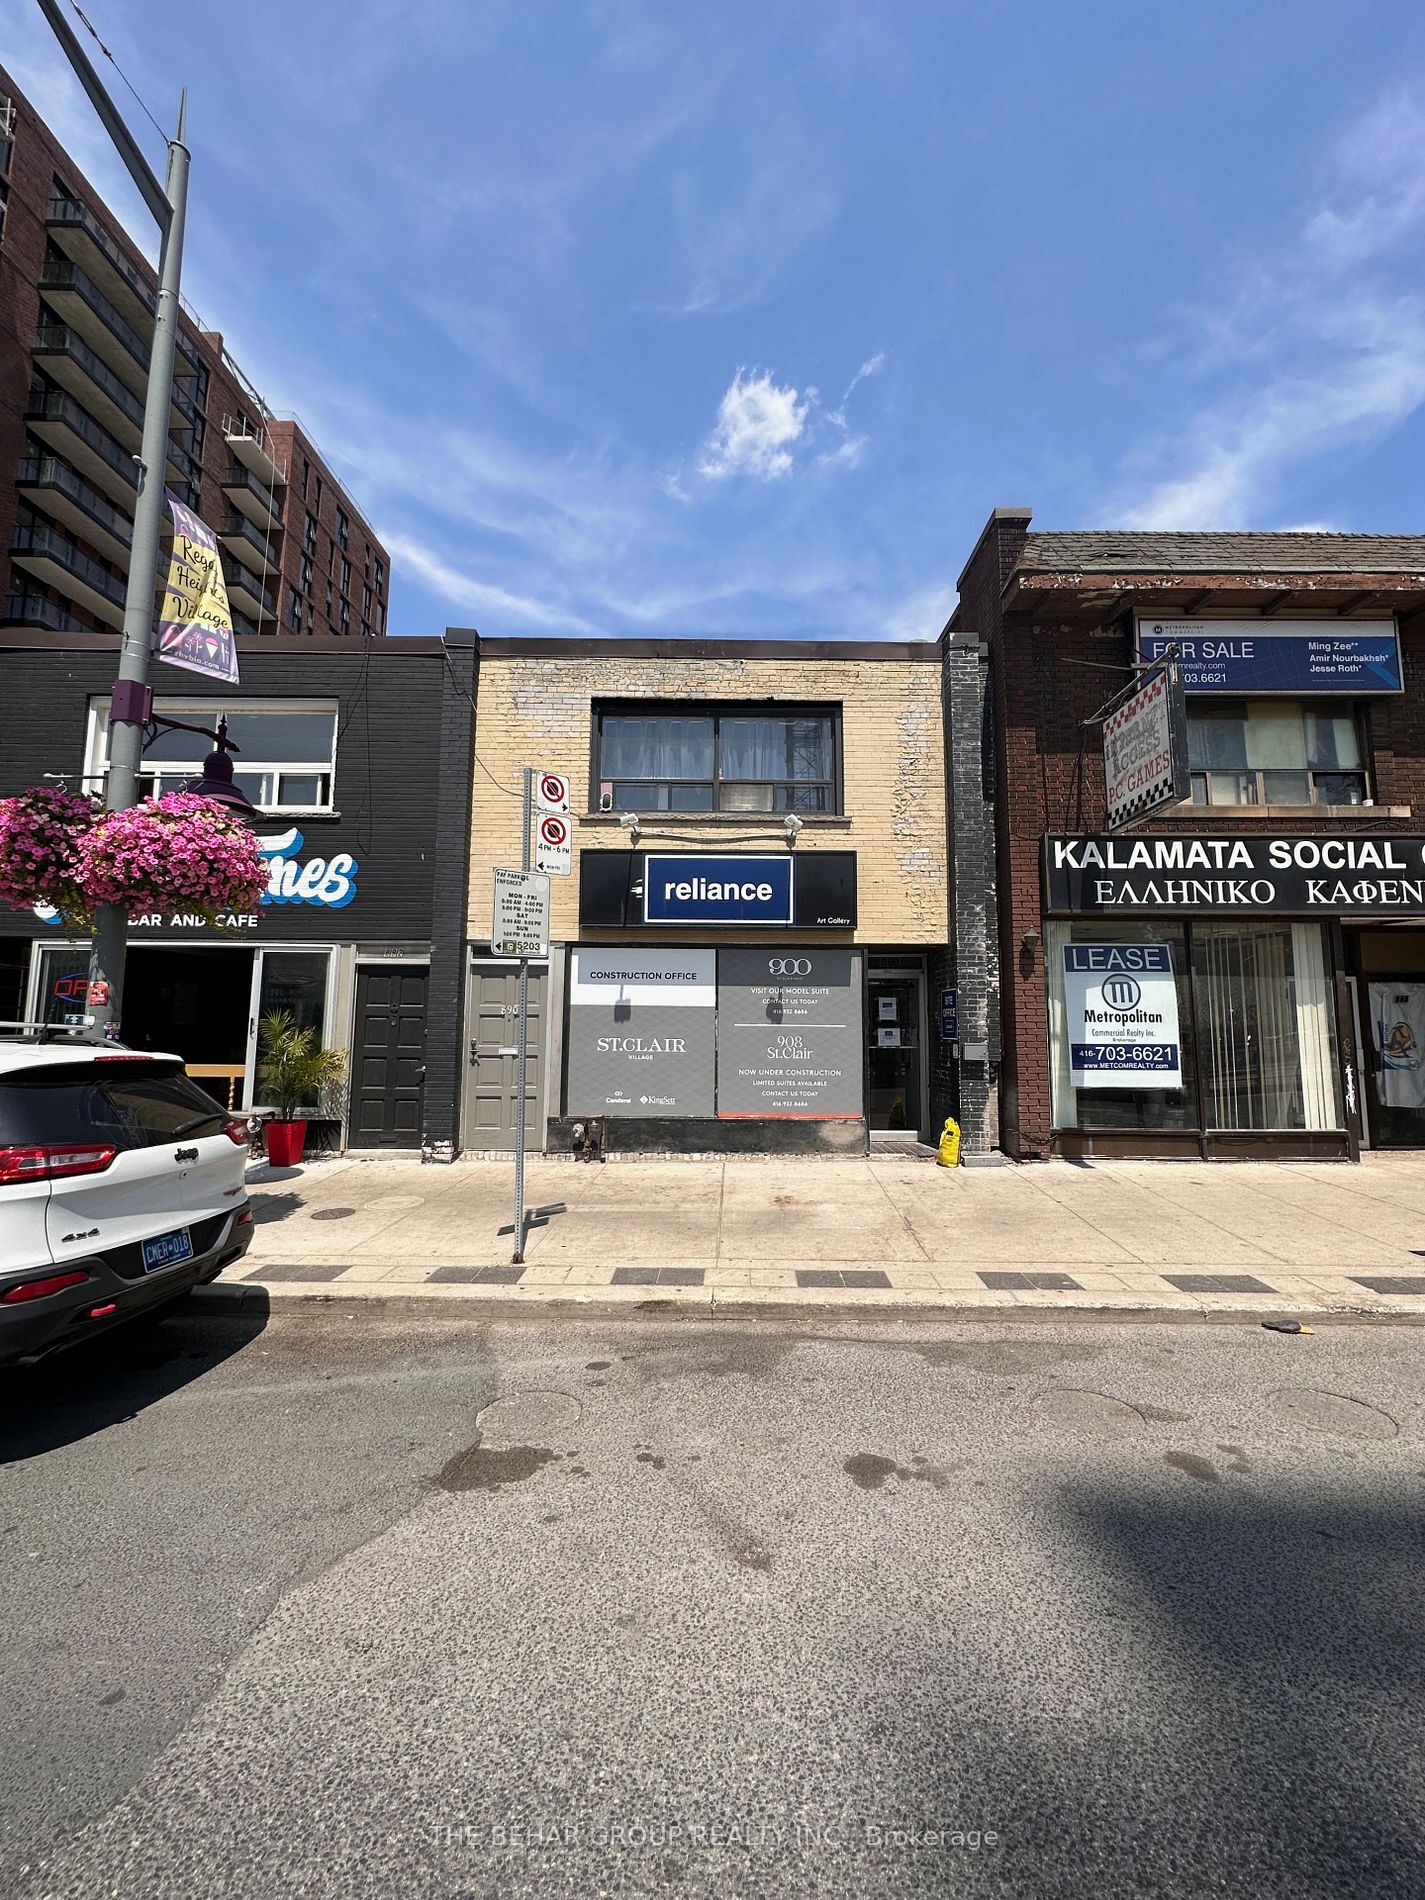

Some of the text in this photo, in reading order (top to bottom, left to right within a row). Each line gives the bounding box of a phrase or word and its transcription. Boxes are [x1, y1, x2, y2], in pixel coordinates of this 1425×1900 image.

[179, 534, 218, 573] Rega
[1202, 641, 1255, 658] SALE
[1308, 641, 1331, 652] Ming
[1309, 654, 1331, 662] Amir
[1310, 664, 1336, 673] Jesse
[1127, 750, 1171, 793] GAMES
[538, 842, 543, 850] 4
[557, 845, 561, 853] 6
[1054, 840, 1255, 870] KALAMATA
[1268, 840, 1407, 870] SOCIAL
[664, 877, 773, 901] reliance
[816, 916, 851, 925] Art Gallery
[517, 941, 541, 951] 5203
[1072, 948, 1162, 970] LEASE
[768, 958, 812, 976] 900
[590, 971, 698, 981] CONSTRUCTION OFFICE
[1084, 1009, 1163, 1027] Metropolitan
[1091, 1028, 1126, 1037] Commercial
[1126, 1028, 1145, 1038] Realty
[597, 1037, 687, 1053] ST.CLAIR
[777, 1035, 803, 1048] 908
[767, 1046, 814, 1059] St.Clair
[785, 1069, 842, 1077] CONSTRUCTION
[174, 1147, 199, 1162] Jeep
